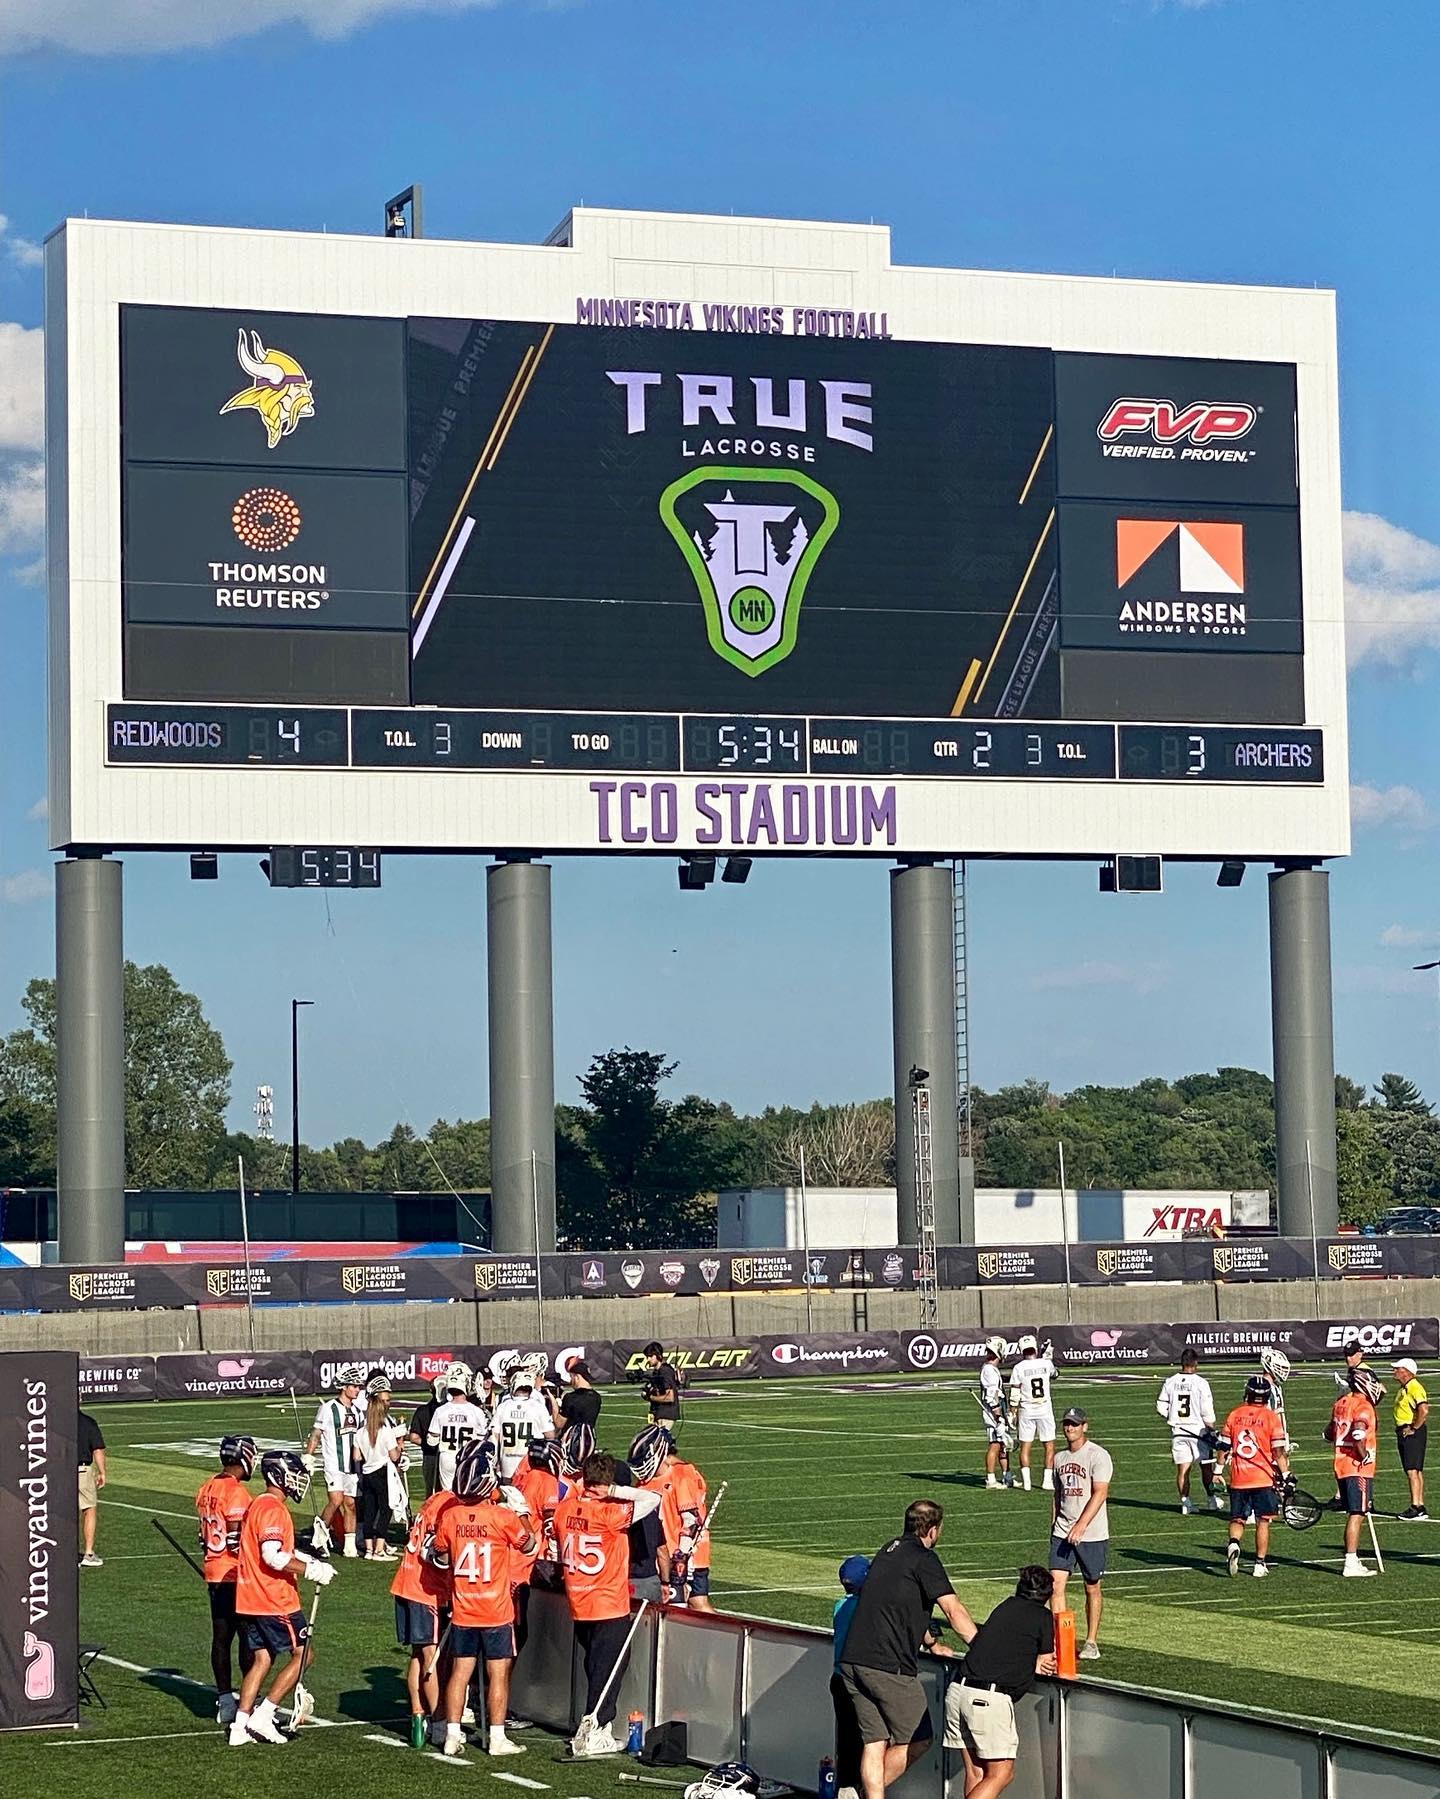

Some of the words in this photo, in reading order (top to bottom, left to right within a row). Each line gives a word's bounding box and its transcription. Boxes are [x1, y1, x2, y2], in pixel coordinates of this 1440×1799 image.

[577, 298, 694, 329] MINNESOTA
[703, 304, 784, 334] VIKINGS
[793, 309, 893, 339] FOOTBALL
[605, 371, 873, 452] TRUE
[1099, 400, 1254, 443] FVP
[682, 440, 815, 462] LACROSSE
[1102, 445, 1176, 460] VERIFIED.
[208, 563, 326, 584] THOMSON
[739, 599, 766, 623] MN
[1119, 601, 1246, 624] ANDERSEN
[1119, 624, 1181, 633] WINDOWS
[1204, 627, 1246, 635] DOORS
[113, 720, 222, 748] REDWOODS
[278, 719, 300, 753] 4
[384, 731, 416, 747] T.O.L.
[436, 723, 451, 755] 3
[482, 733, 522, 749] DOWN
[572, 734, 590, 749] TO
[591, 735, 610, 750] GO
[718, 726, 799, 764] 5:34
[812, 739, 840, 755] BALL
[840, 739, 858, 755] ON
[933, 741, 958, 756] QTR
[973, 730, 992, 768] 2
[1027, 734, 1042, 765] 3
[1057, 743, 1087, 759] T.O.L.
[1187, 735, 1206, 772] 3
[1234, 743, 1313, 767] ARCHERS
[590, 782, 678, 843] TCO
[695, 783, 896, 845] STADIUM
[302, 851, 377, 883] 5:34
[1146, 1206, 1223, 1234] XTRA
[93, 1279, 135, 1287] LACROSSE
[230, 1276, 271, 1284] LACOSSE
[366, 1272, 406, 1280] LACROSSE
[1186, 1332, 1230, 1344] ATHLETIC
[1233, 1332, 1276, 1344] BREWING
[1326, 1325, 1412, 1347] EPOCH
[625, 1350, 751, 1371] QOLLAR
[772, 1343, 889, 1367] Champion
[940, 1343, 1021, 1358] WARO
[1062, 1345, 1116, 1362] vineyard
[1117, 1347, 1149, 1359] vines
[79, 1369, 122, 1381] REWING
[185, 1377, 246, 1394] vineyard
[247, 1376, 284, 1388] vines
[95, 1384, 118, 1392] BREWS
[1031, 1378, 1045, 1398] 8
[1178, 1395, 1191, 1418] 3
[20, 1379, 47, 1468] vines
[502, 1422, 534, 1447] 94
[441, 1426, 473, 1450] 46
[1237, 1430, 1258, 1459] 8
[1058, 1462, 1087, 1480] RCHERS
[456, 1524, 488, 1538] ROBBINS
[19, 1474, 57, 1624] vineyard
[562, 1533, 606, 1577] 45
[454, 1541, 493, 1584] 41
